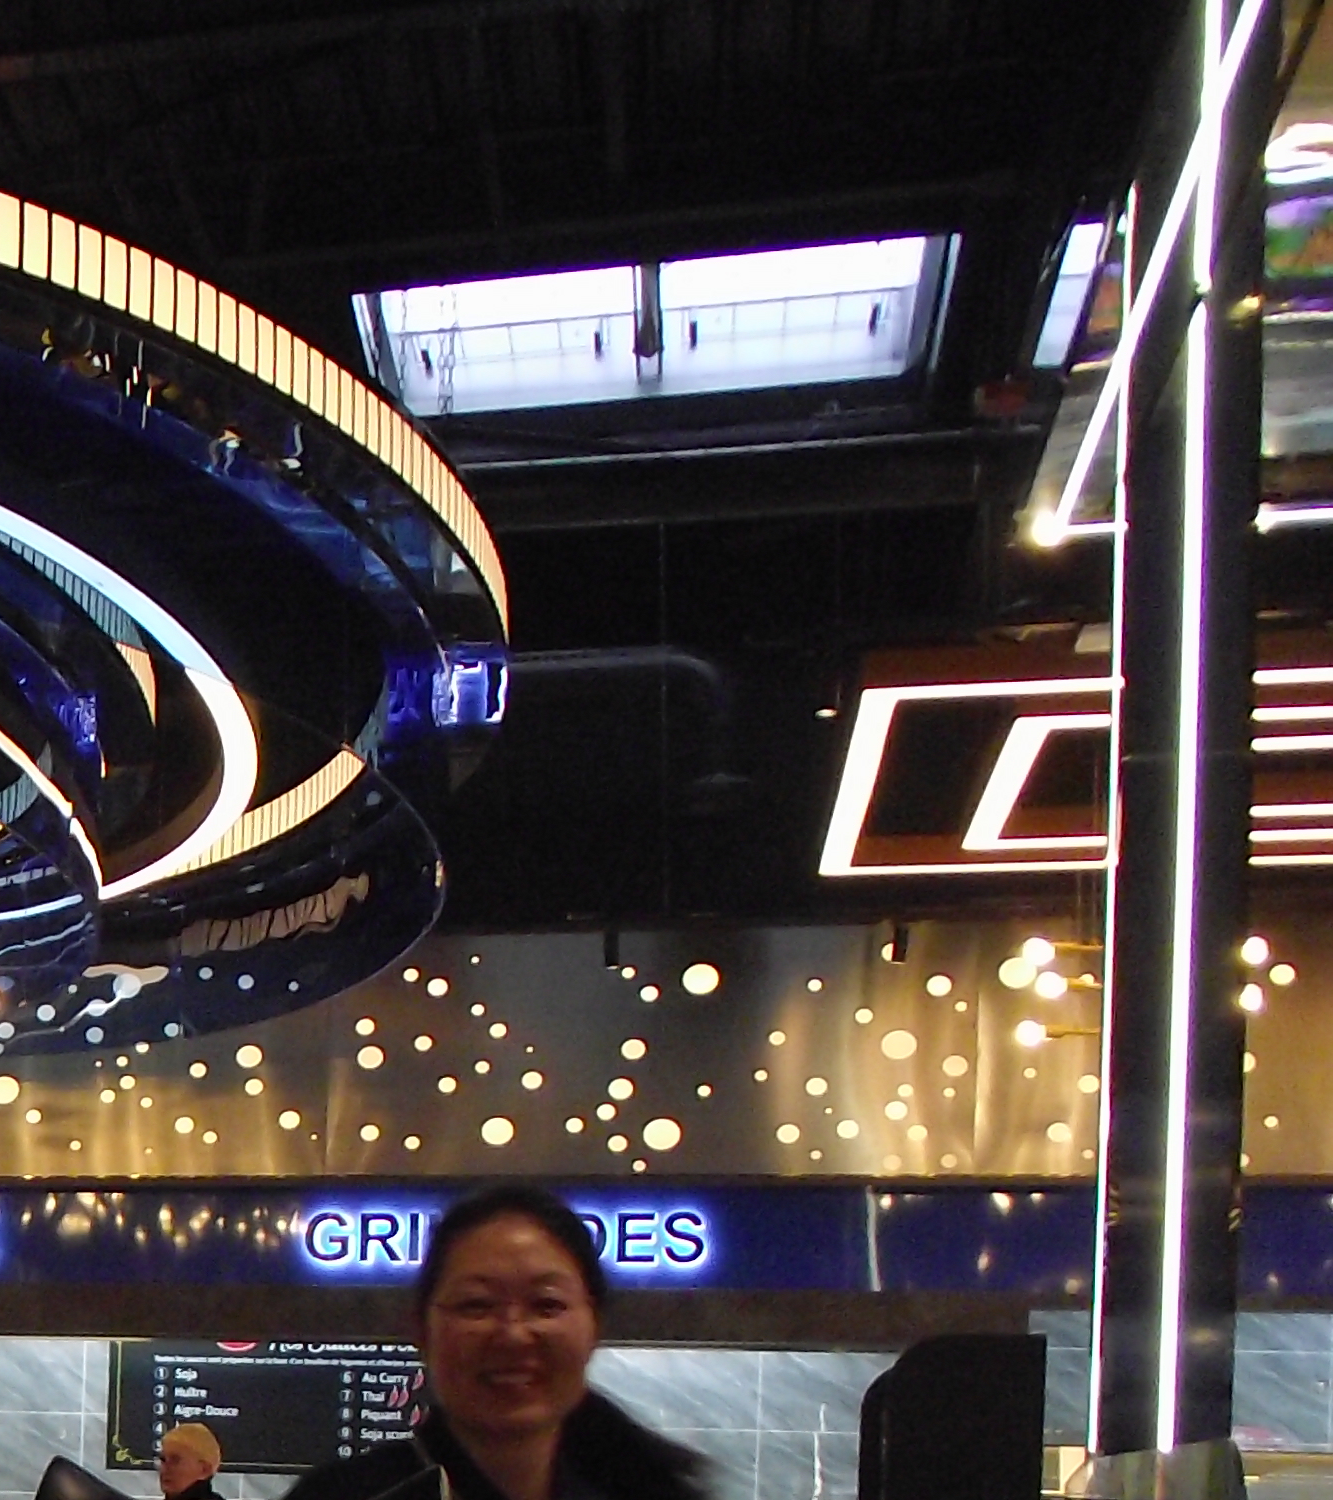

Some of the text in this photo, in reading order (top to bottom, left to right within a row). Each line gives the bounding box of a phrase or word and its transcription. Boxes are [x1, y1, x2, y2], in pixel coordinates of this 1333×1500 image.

[304, 1210, 706, 1263] GRIES
[175, 1367, 198, 1382] Soja
[361, 1372, 378, 1384] Au
[379, 1372, 410, 1387] Curry
[174, 1404, 240, 1418] Aigre-Douce
